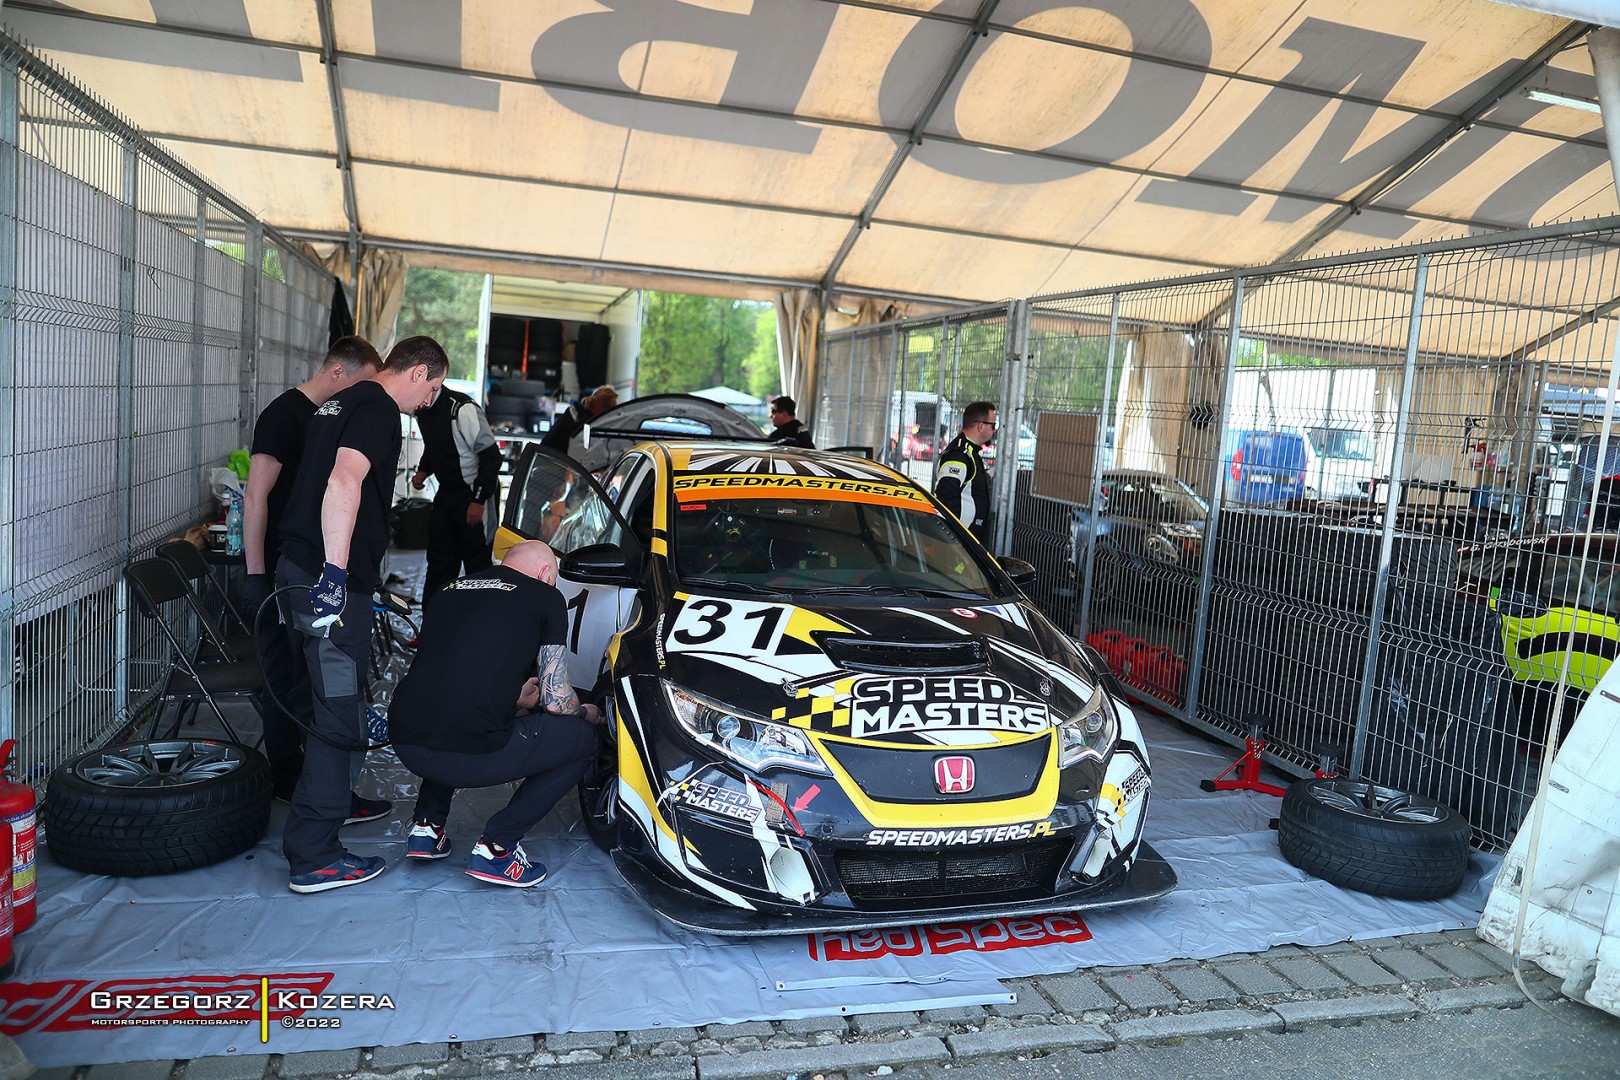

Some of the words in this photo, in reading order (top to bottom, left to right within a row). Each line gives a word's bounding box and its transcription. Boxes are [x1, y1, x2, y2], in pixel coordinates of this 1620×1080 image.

[674, 477, 924, 502] SPEEDMASTERS.PL
[673, 598, 786, 652] 31
[857, 677, 1012, 704] SPEED
[855, 701, 1048, 736] MASTERS
[685, 792, 759, 821] MASTERS
[694, 782, 750, 807] SPEED
[866, 821, 1057, 847] SPEEDMASTERS.PL
